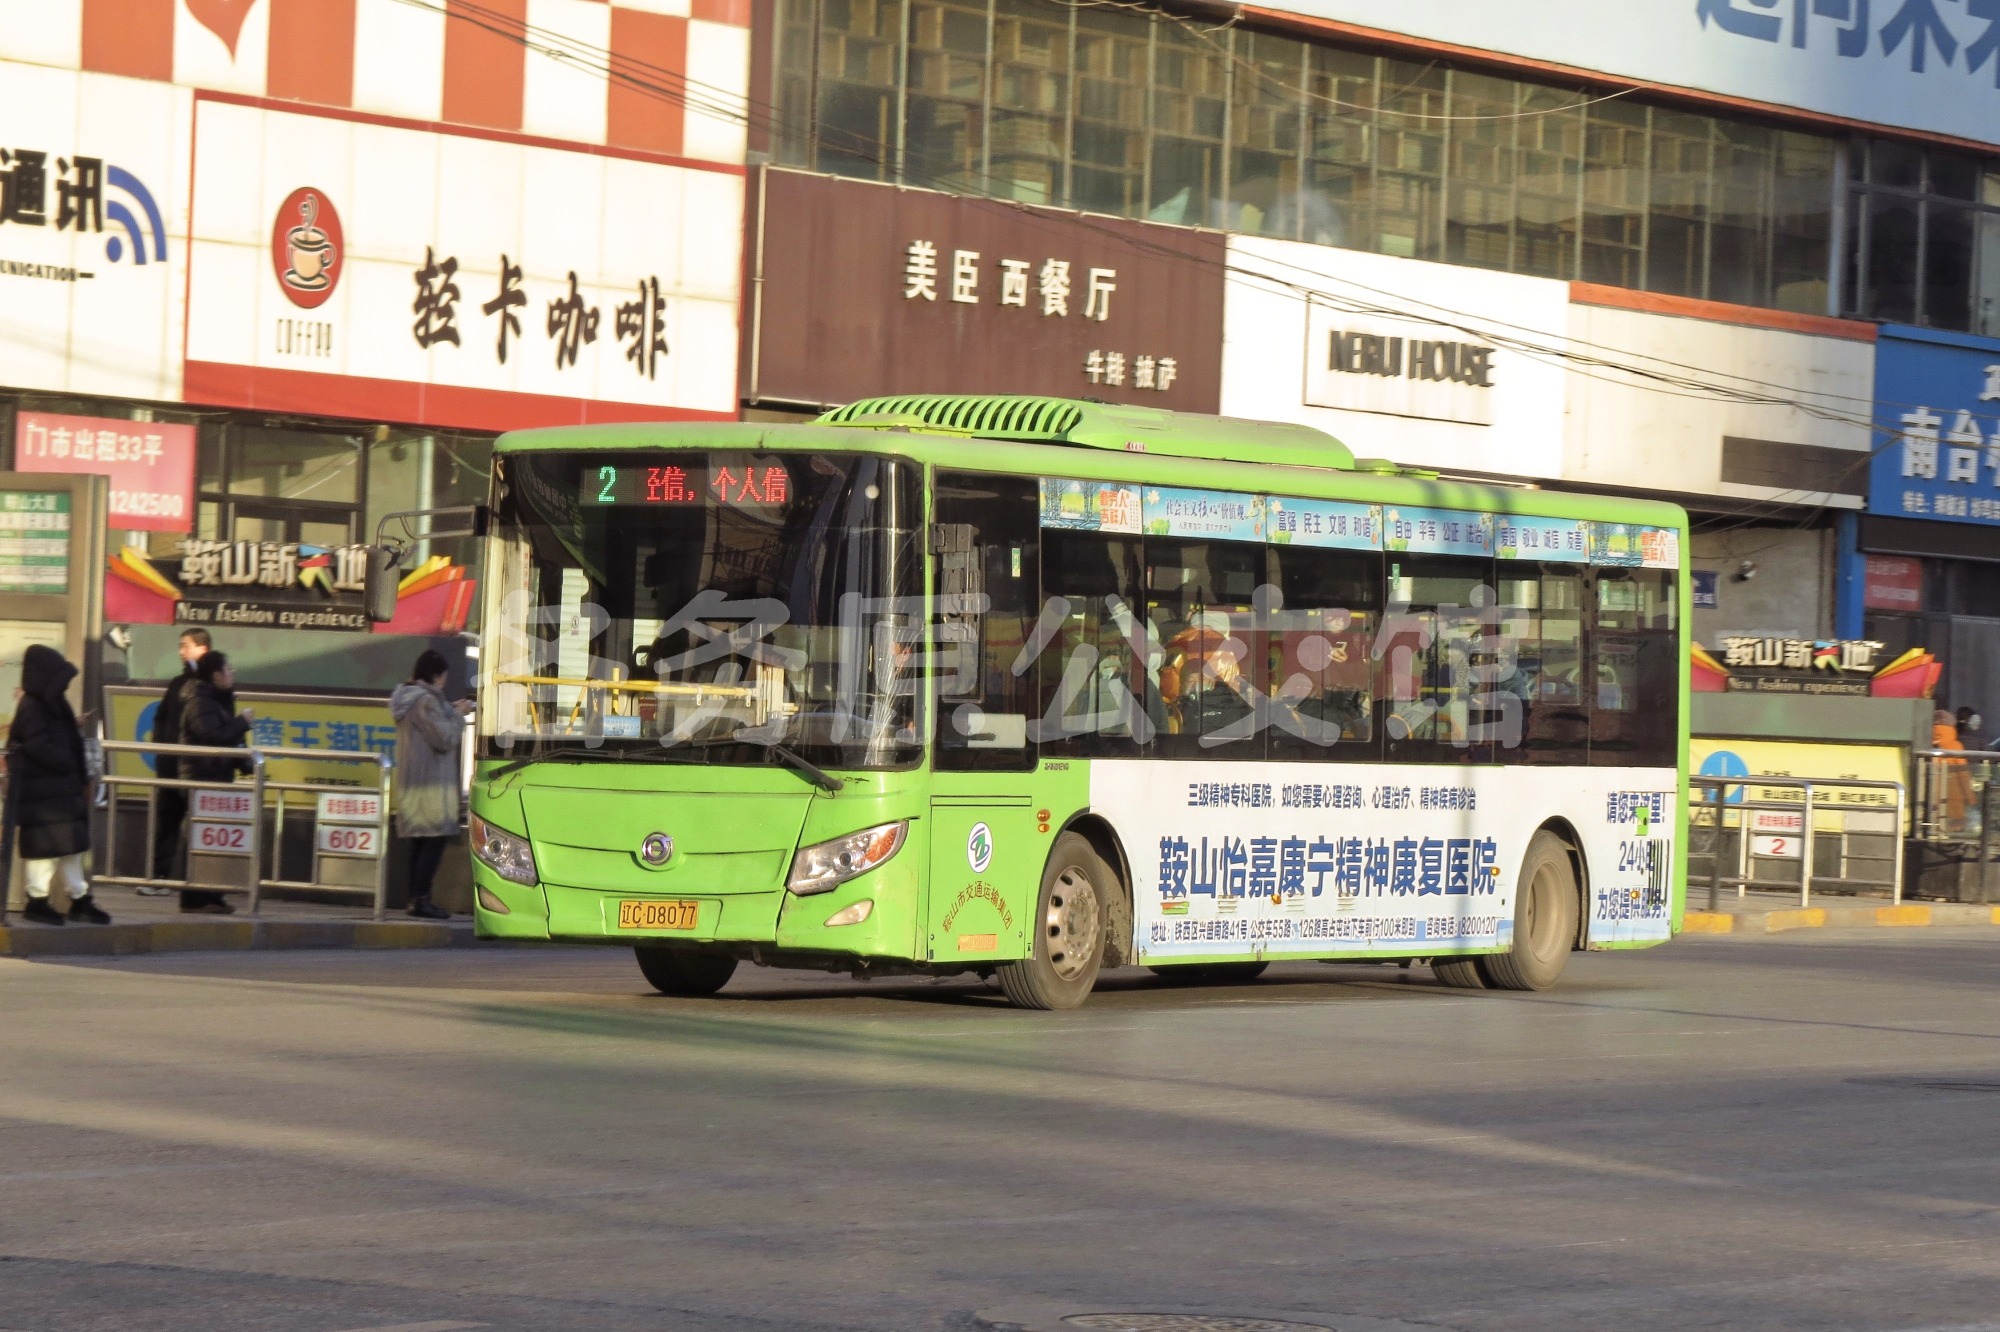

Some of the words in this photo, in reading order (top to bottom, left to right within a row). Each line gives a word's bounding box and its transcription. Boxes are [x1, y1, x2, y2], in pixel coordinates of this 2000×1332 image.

[905, 240, 1117, 322] 美臣西餐厅
[412, 246, 668, 380] 轻卡咖啡
[1085, 349, 1125, 386] 牛排
[1409, 339, 1496, 388] HOUSE
[25, 421, 164, 466] 门市出租33平
[599, 466, 616, 502] 2
[1278, 510, 1297, 533] 富强
[1304, 512, 1322, 534] 民主
[1328, 514, 1346, 536] 文明
[1353, 516, 1371, 538] 和谐
[1395, 518, 1412, 540] 自由
[1419, 520, 1437, 542] 平等
[1443, 521, 1460, 543] 公正
[1465, 523, 1483, 545] 法治
[1501, 526, 1517, 547] 爱国
[1523, 528, 1539, 548] 敬业
[1566, 531, 1582, 551] 友善
[175, 602, 213, 621] New
[215, 602, 276, 625] fashion
[279, 607, 365, 629] experience
[202, 827, 244, 847] 602
[329, 831, 371, 850] 602
[1772, 838, 1786, 854] 2
[1158, 835, 1497, 899] 鞍山怡嘉康宁精神康复医院
[942, 880, 1013, 933] 鞍山市交通运输集团
